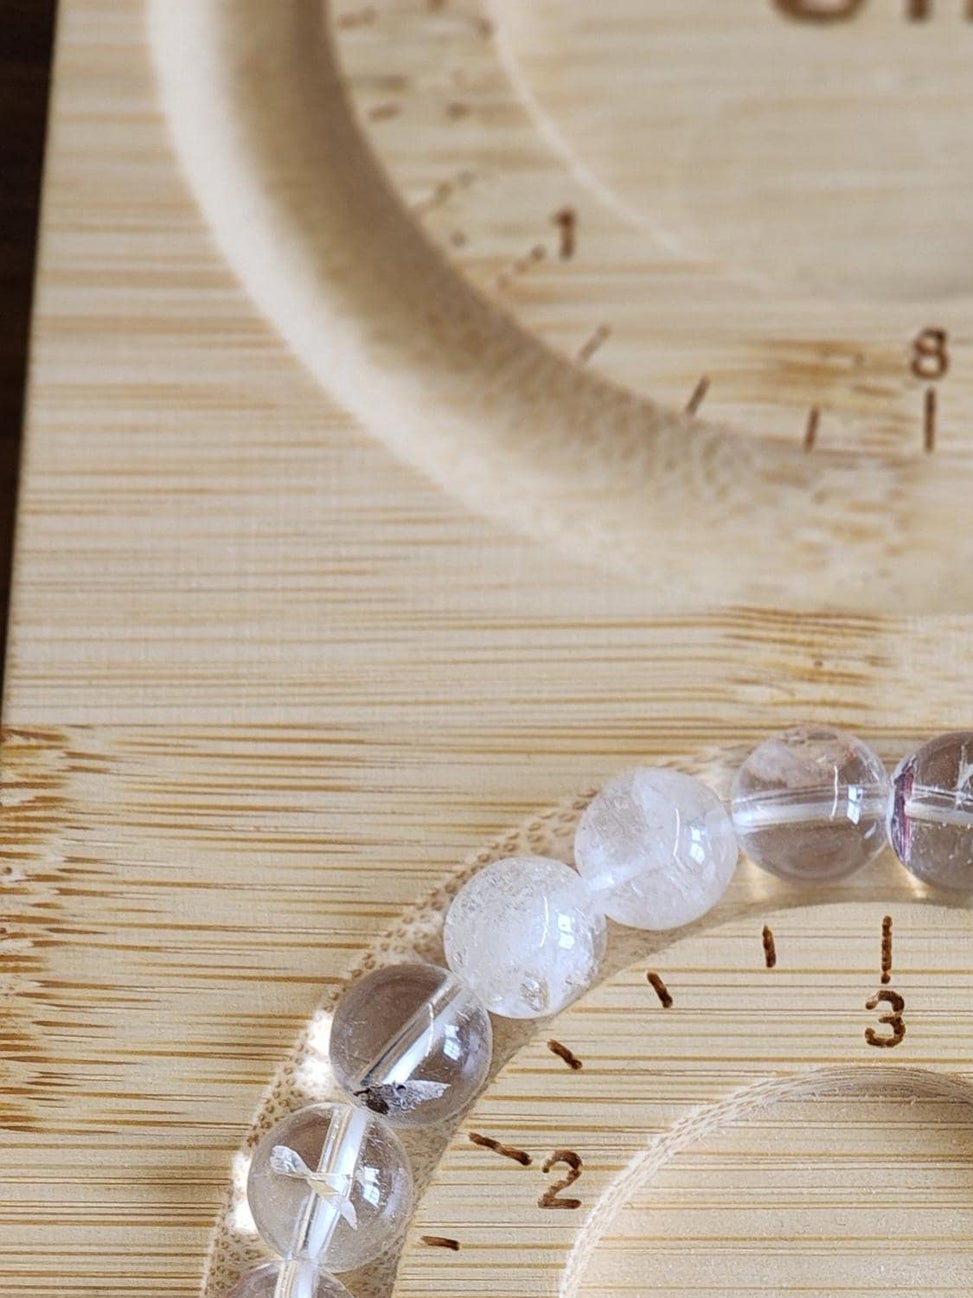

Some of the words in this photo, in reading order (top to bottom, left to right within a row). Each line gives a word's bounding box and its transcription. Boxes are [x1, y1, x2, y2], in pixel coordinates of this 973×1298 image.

[551, 208, 576, 259] 1
[910, 328, 950, 381] 8
[864, 990, 907, 1047] 3
[537, 1150, 582, 1209] 2
